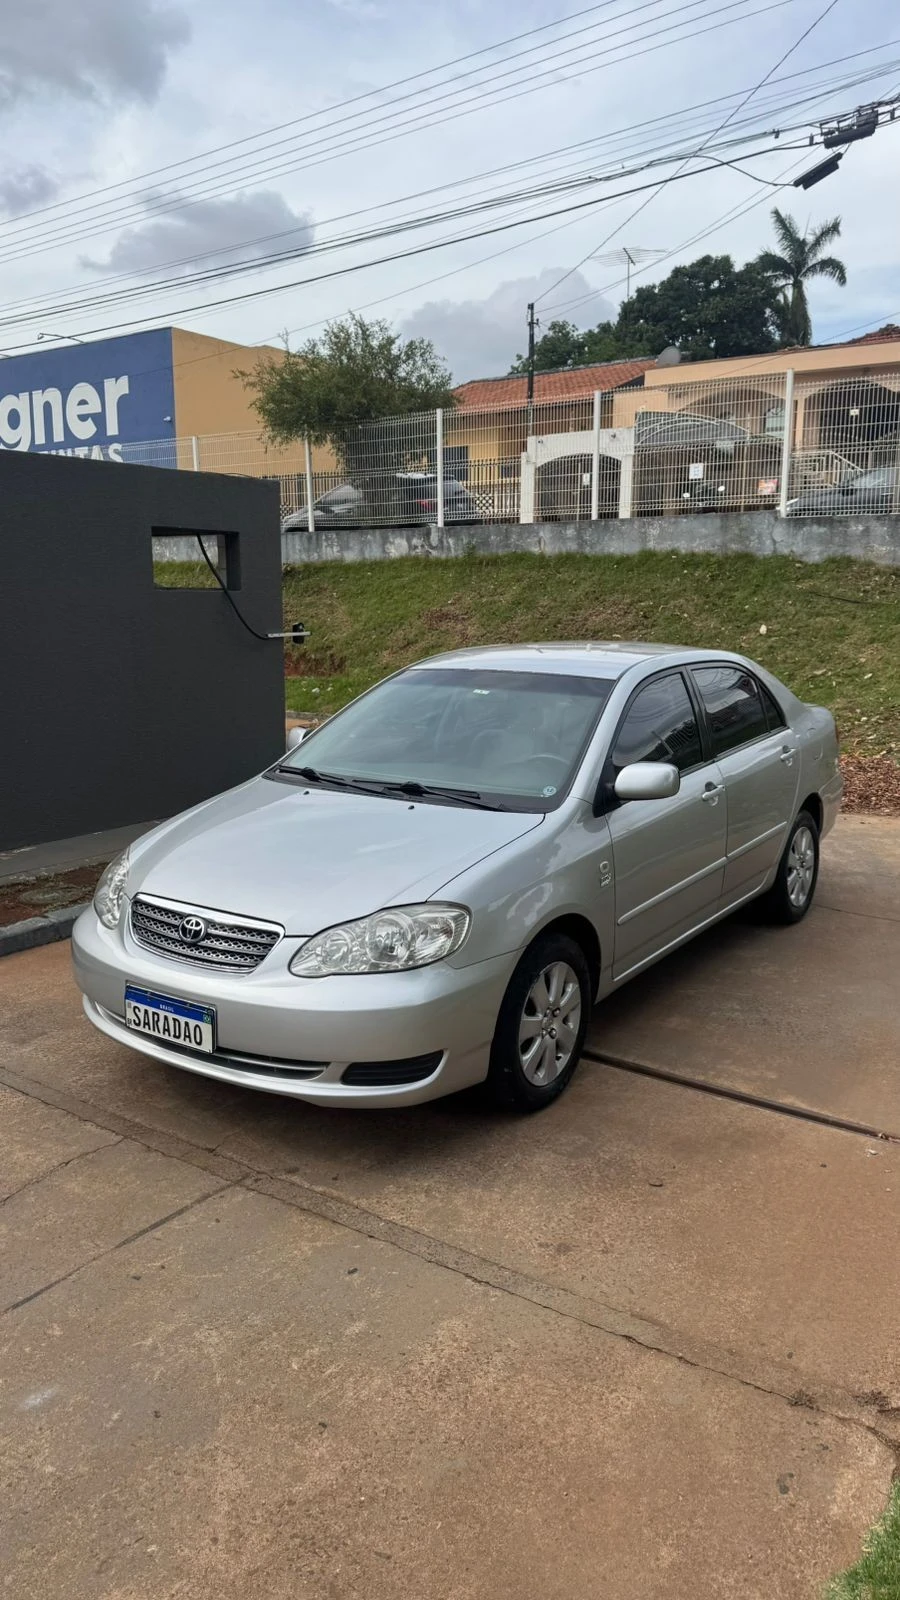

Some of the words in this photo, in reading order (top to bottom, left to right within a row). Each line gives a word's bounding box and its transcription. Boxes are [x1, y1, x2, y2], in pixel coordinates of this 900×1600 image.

[0, 375, 129, 452] gner
[133, 1006, 203, 1046] SARADAO
[159, 1003, 175, 1013] BRASIL
